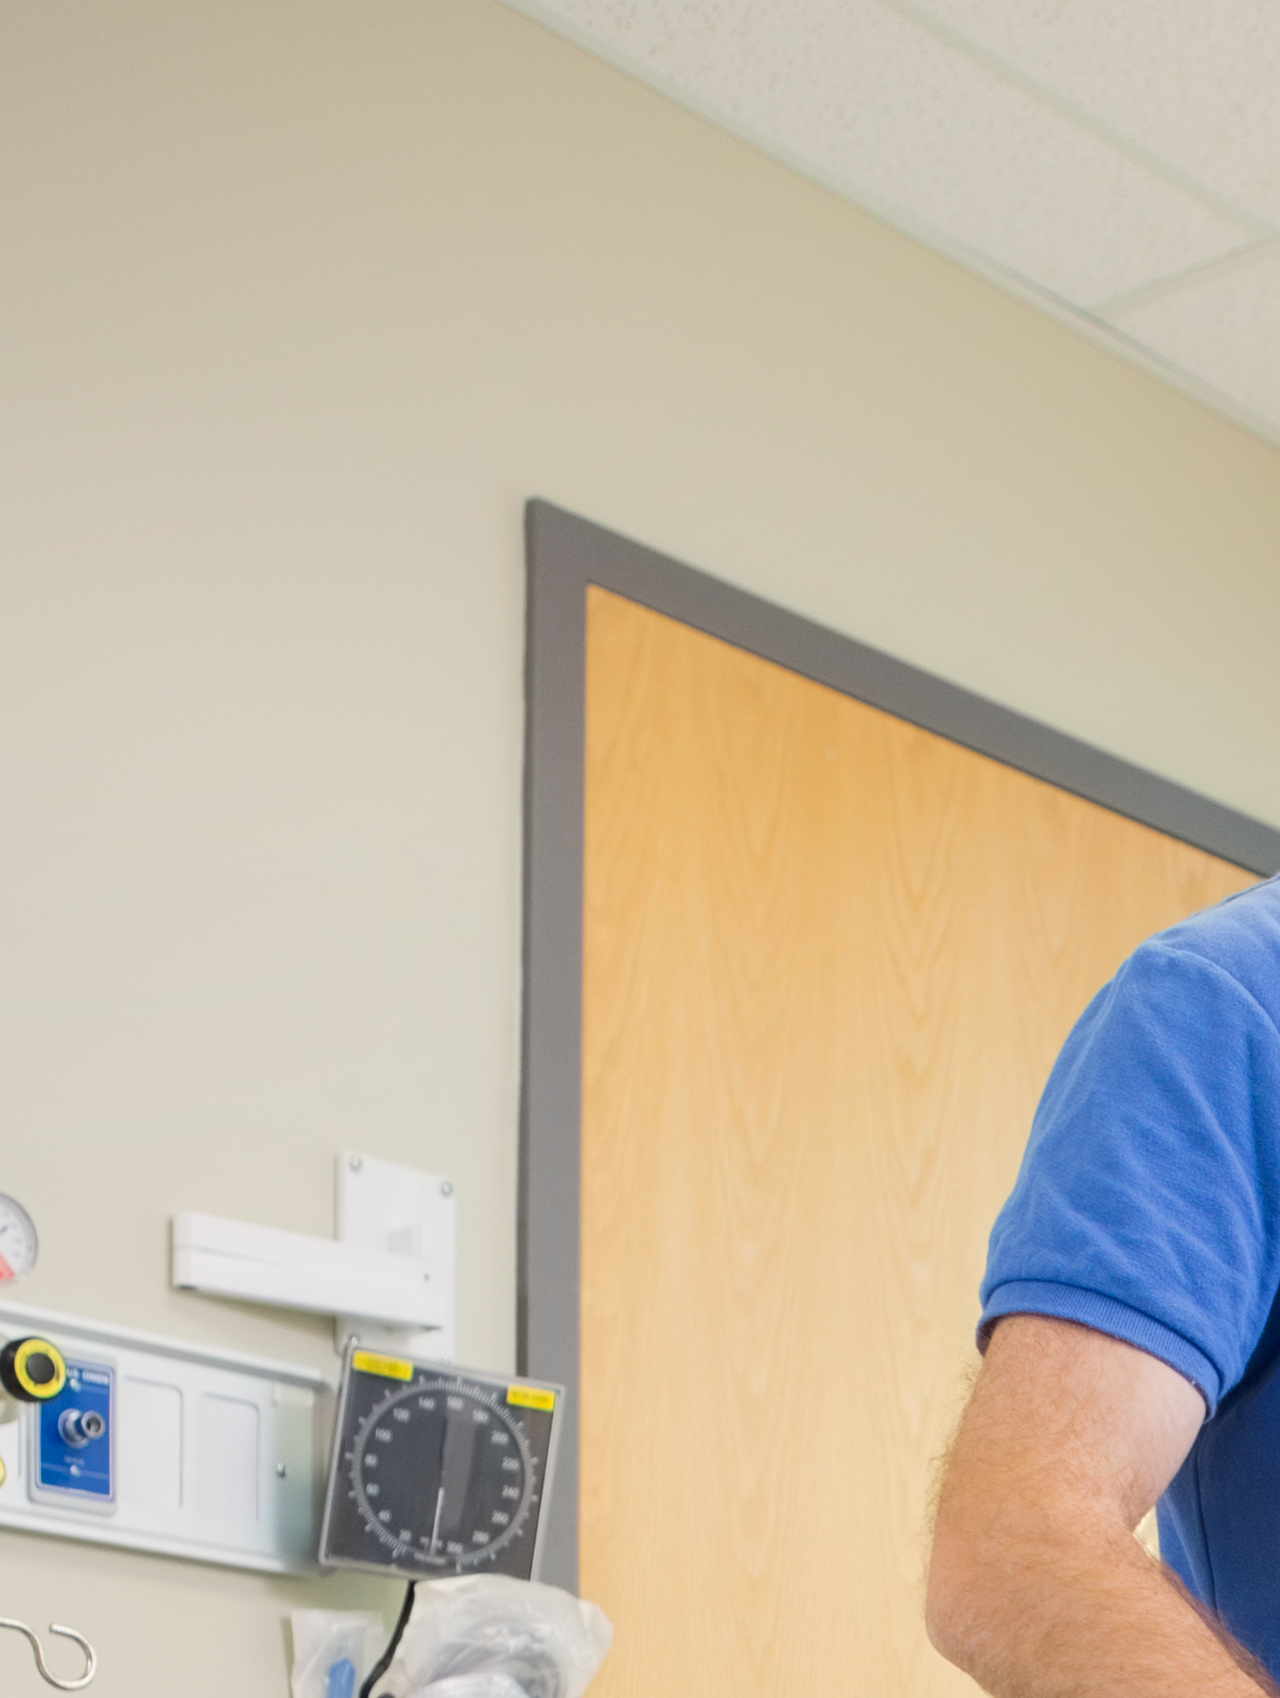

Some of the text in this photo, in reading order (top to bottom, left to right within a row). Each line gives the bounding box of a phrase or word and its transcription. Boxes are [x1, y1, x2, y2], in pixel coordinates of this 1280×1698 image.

[418, 1396, 436, 1411] 140
[446, 1395, 464, 1411] 160
[392, 1407, 410, 1422] 120
[375, 1428, 392, 1442] 100
[490, 1429, 509, 1445] 200
[501, 1456, 520, 1471] 220
[501, 1484, 519, 1499] 240
